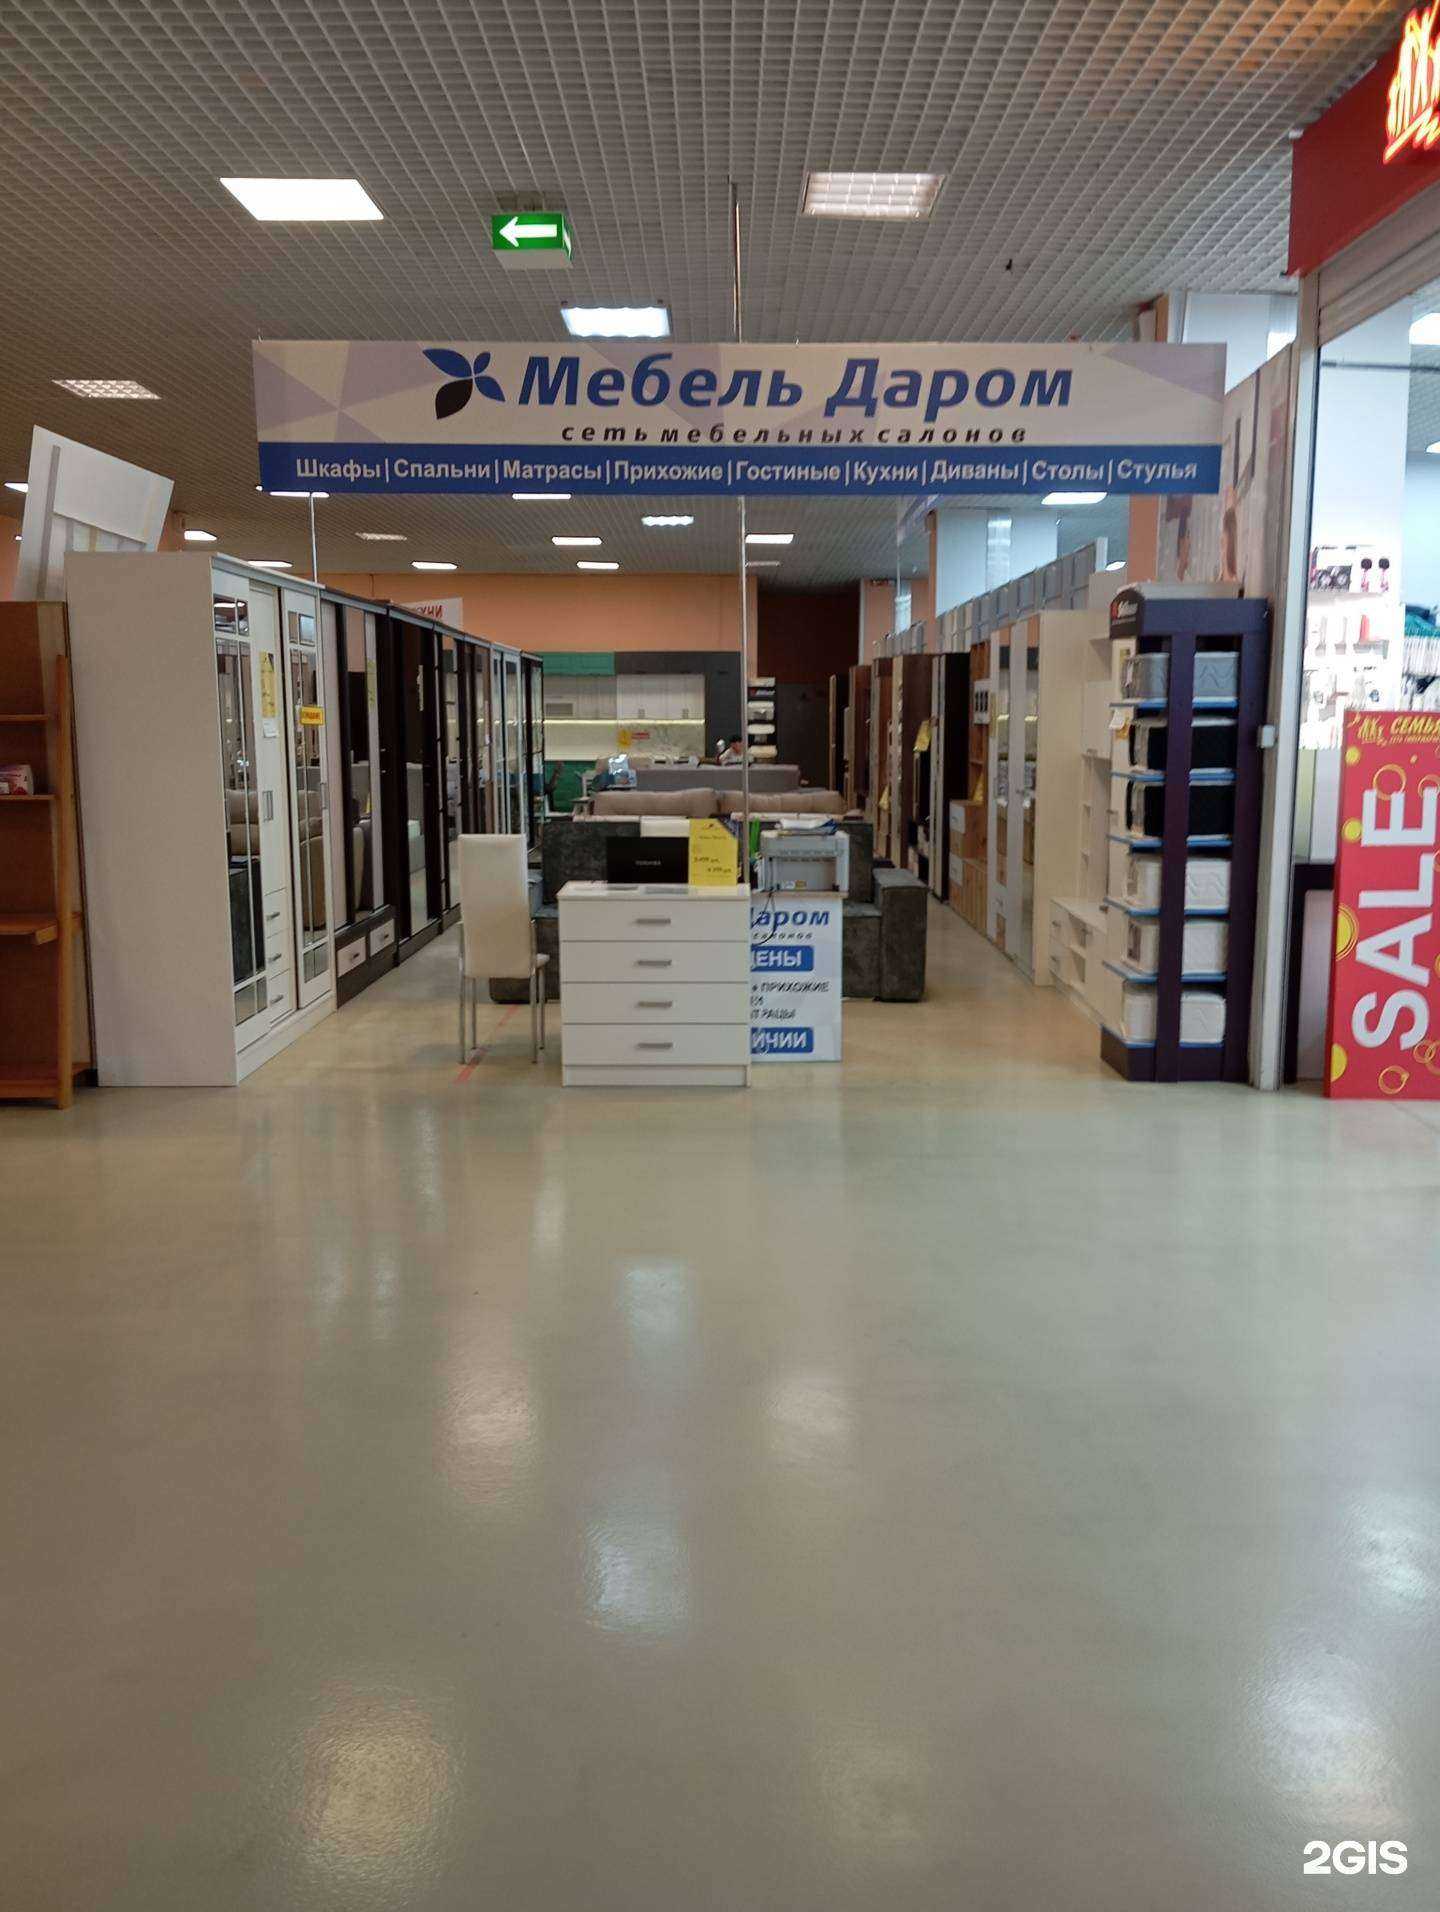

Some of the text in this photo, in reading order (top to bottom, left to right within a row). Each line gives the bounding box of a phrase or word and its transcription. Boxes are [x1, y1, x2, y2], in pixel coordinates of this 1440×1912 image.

[518, 352, 1074, 423] Мебель Даром
[561, 423, 1027, 444] сеть мебельных салонов
[296, 459, 1197, 485] Шкафы Спальни Матрасы Прихожие Гостиные Кухни Диваны Столы Стулья
[751, 907, 830, 932] аром
[1351, 786, 1438, 1051] SALE
